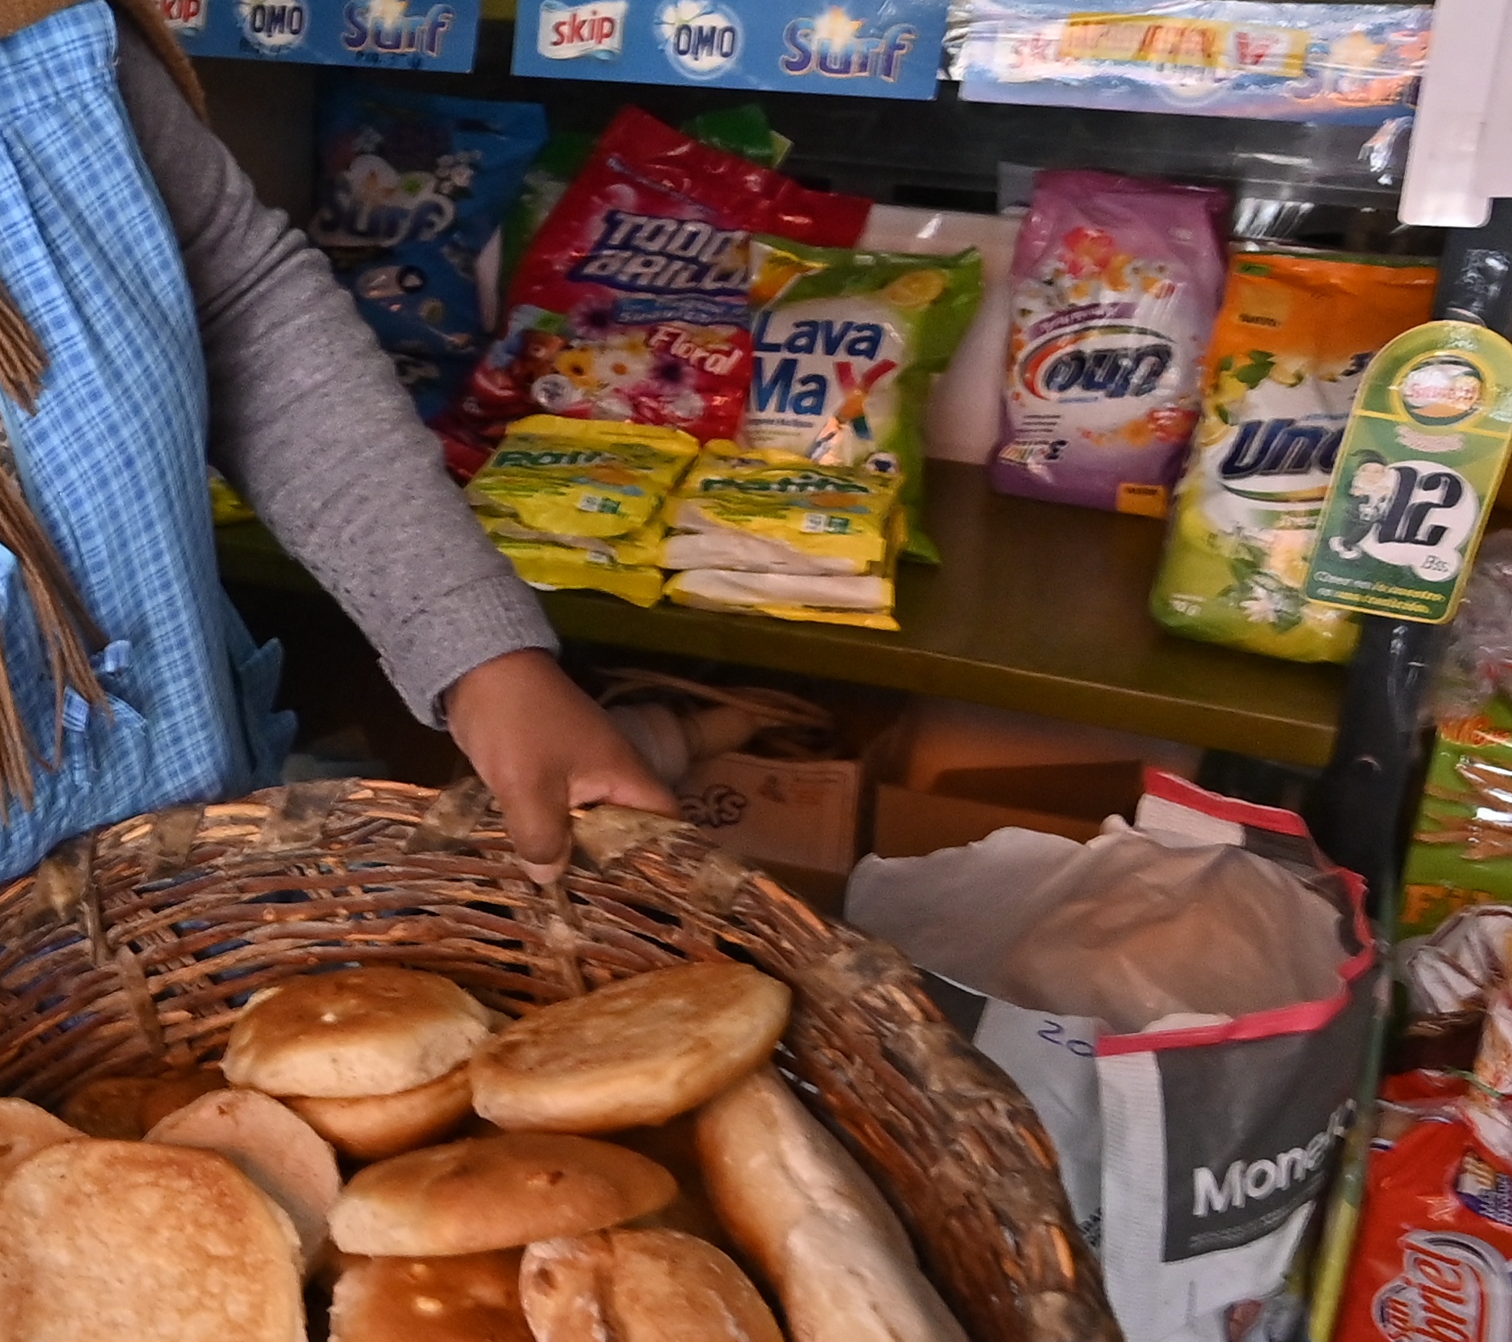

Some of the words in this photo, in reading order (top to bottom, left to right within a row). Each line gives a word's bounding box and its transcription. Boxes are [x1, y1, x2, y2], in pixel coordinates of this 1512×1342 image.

[251, 1, 304, 38] OMO
[551, 11, 615, 48] skip
[677, 22, 736, 61] OMO
[780, 15, 916, 83] Surf
[648, 326, 743, 376] Floral
[754, 315, 883, 358] Lava
[1043, 346, 1173, 397] Uno
[1378, 465, 1463, 546] 12
